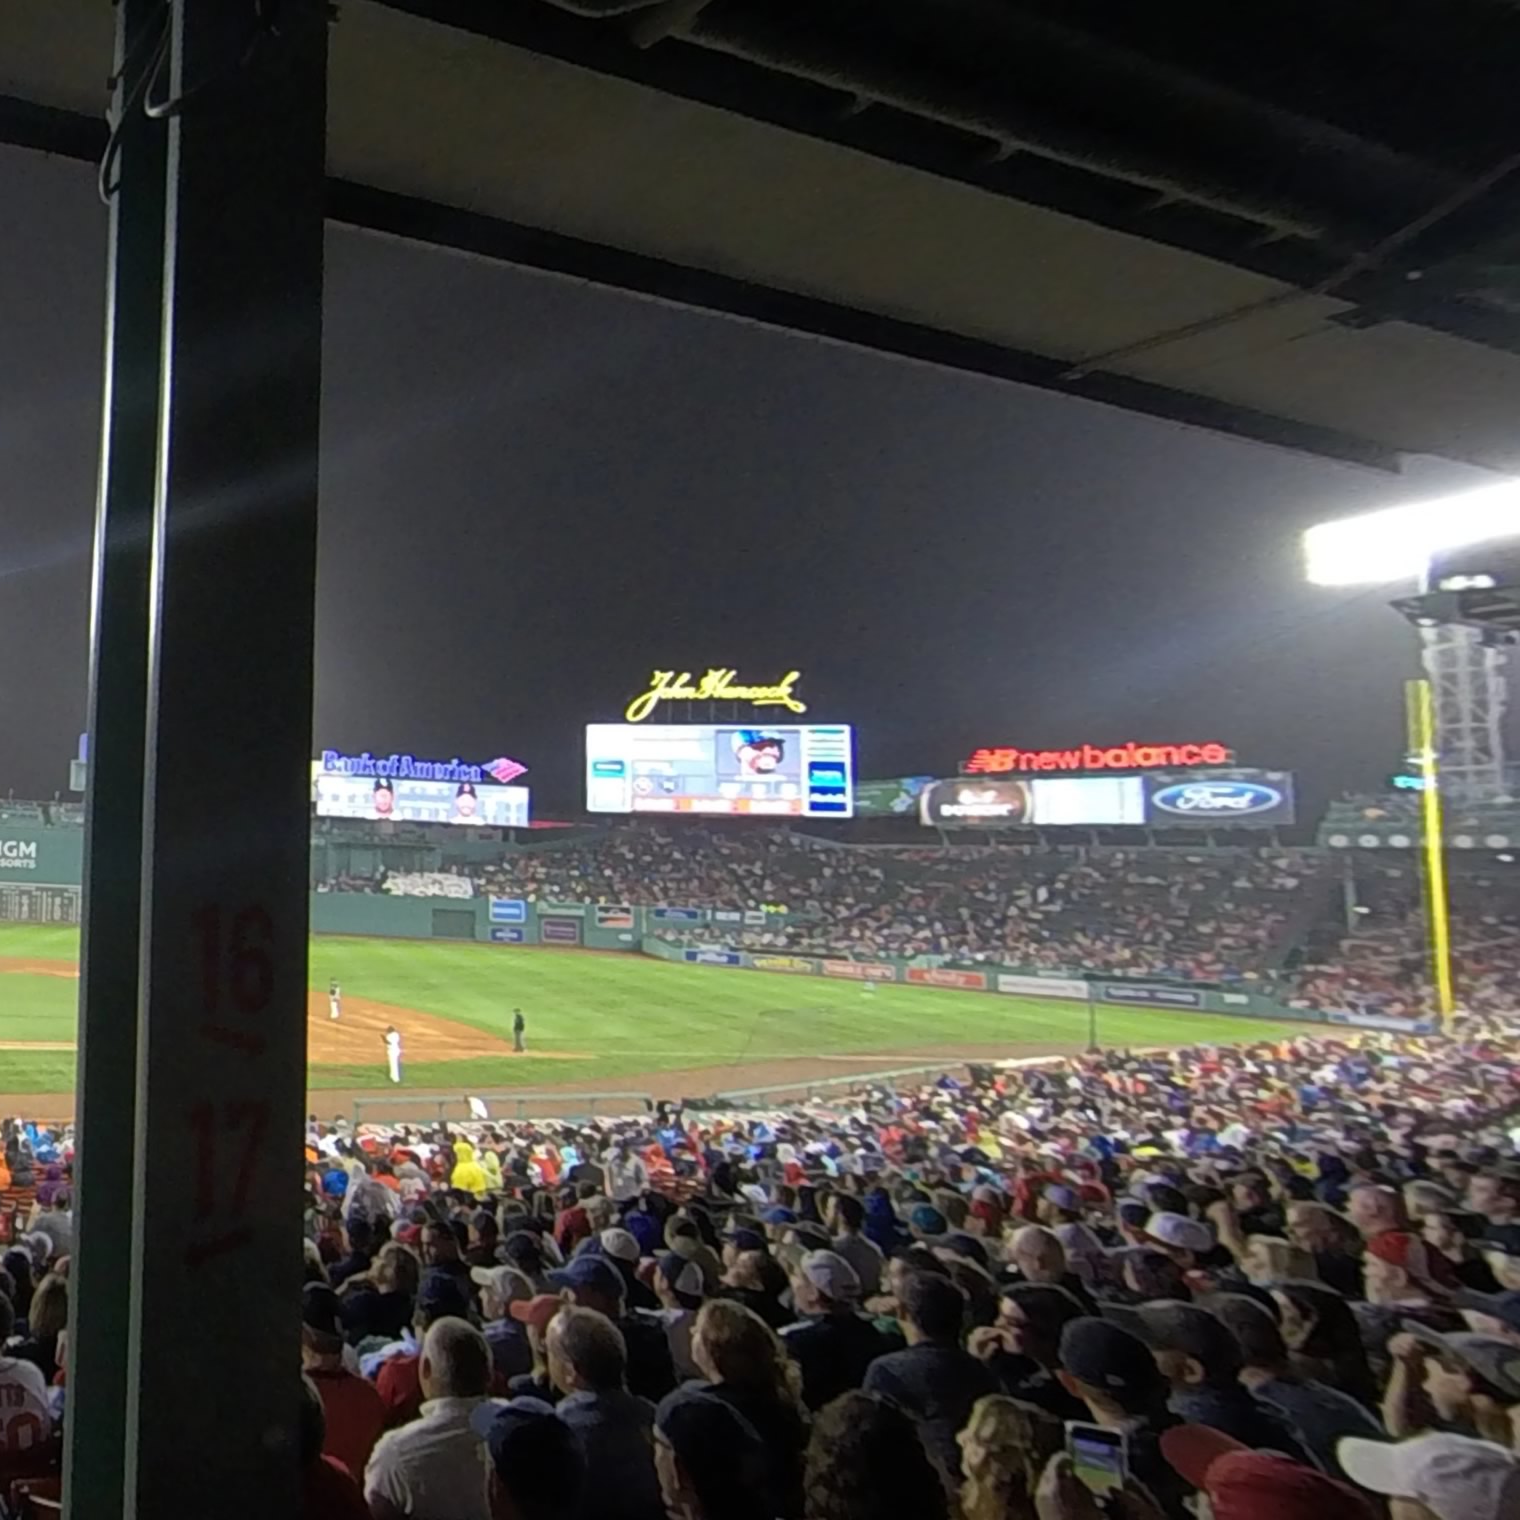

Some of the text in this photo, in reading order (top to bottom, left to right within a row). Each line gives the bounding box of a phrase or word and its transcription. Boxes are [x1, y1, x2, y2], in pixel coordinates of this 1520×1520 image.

[627, 669, 808, 722] John Hancock
[322, 750, 482, 782] Bank of America
[1176, 786, 1253, 809] Ford
[188, 902, 274, 1015] 16
[184, 1098, 270, 1219] 17
